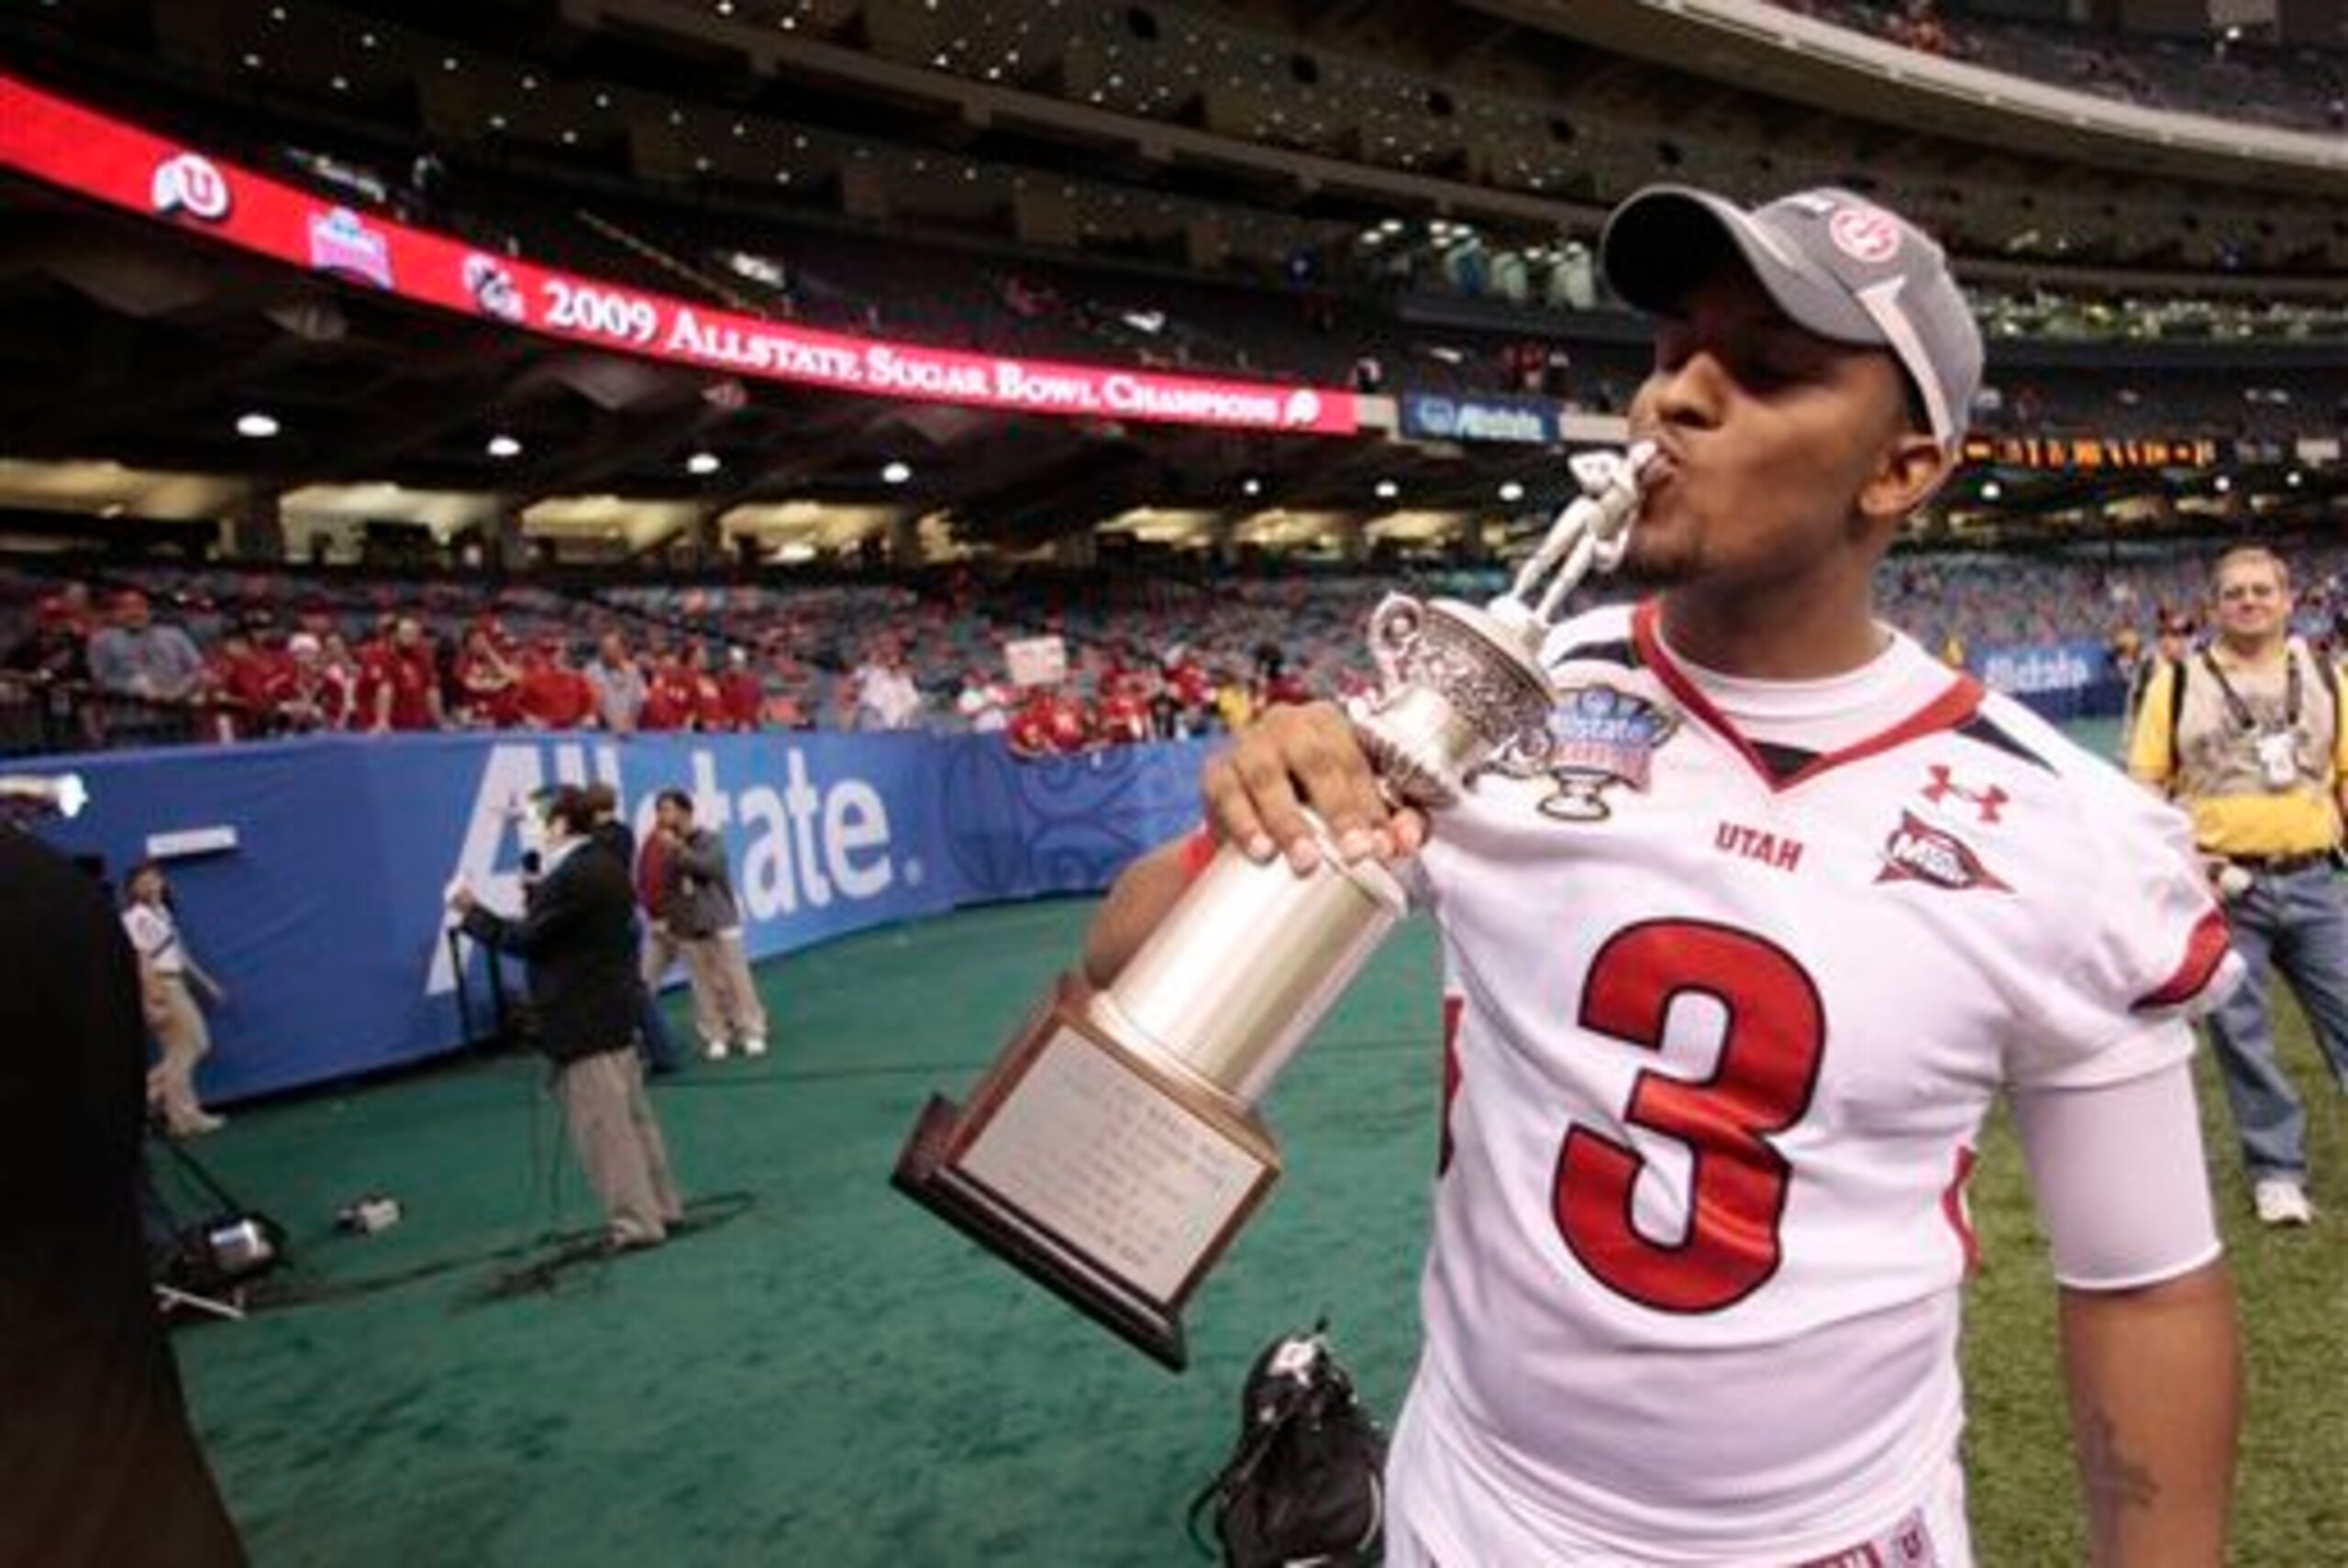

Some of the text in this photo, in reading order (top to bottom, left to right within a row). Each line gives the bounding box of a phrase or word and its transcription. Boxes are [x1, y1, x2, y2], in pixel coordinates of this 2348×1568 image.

[544, 282, 657, 341] 2009
[995, 362, 1101, 405] BOWL
[426, 743, 894, 996] Atate
[1714, 822, 1804, 871] UTAH
[1551, 917, 1827, 1315] 3
